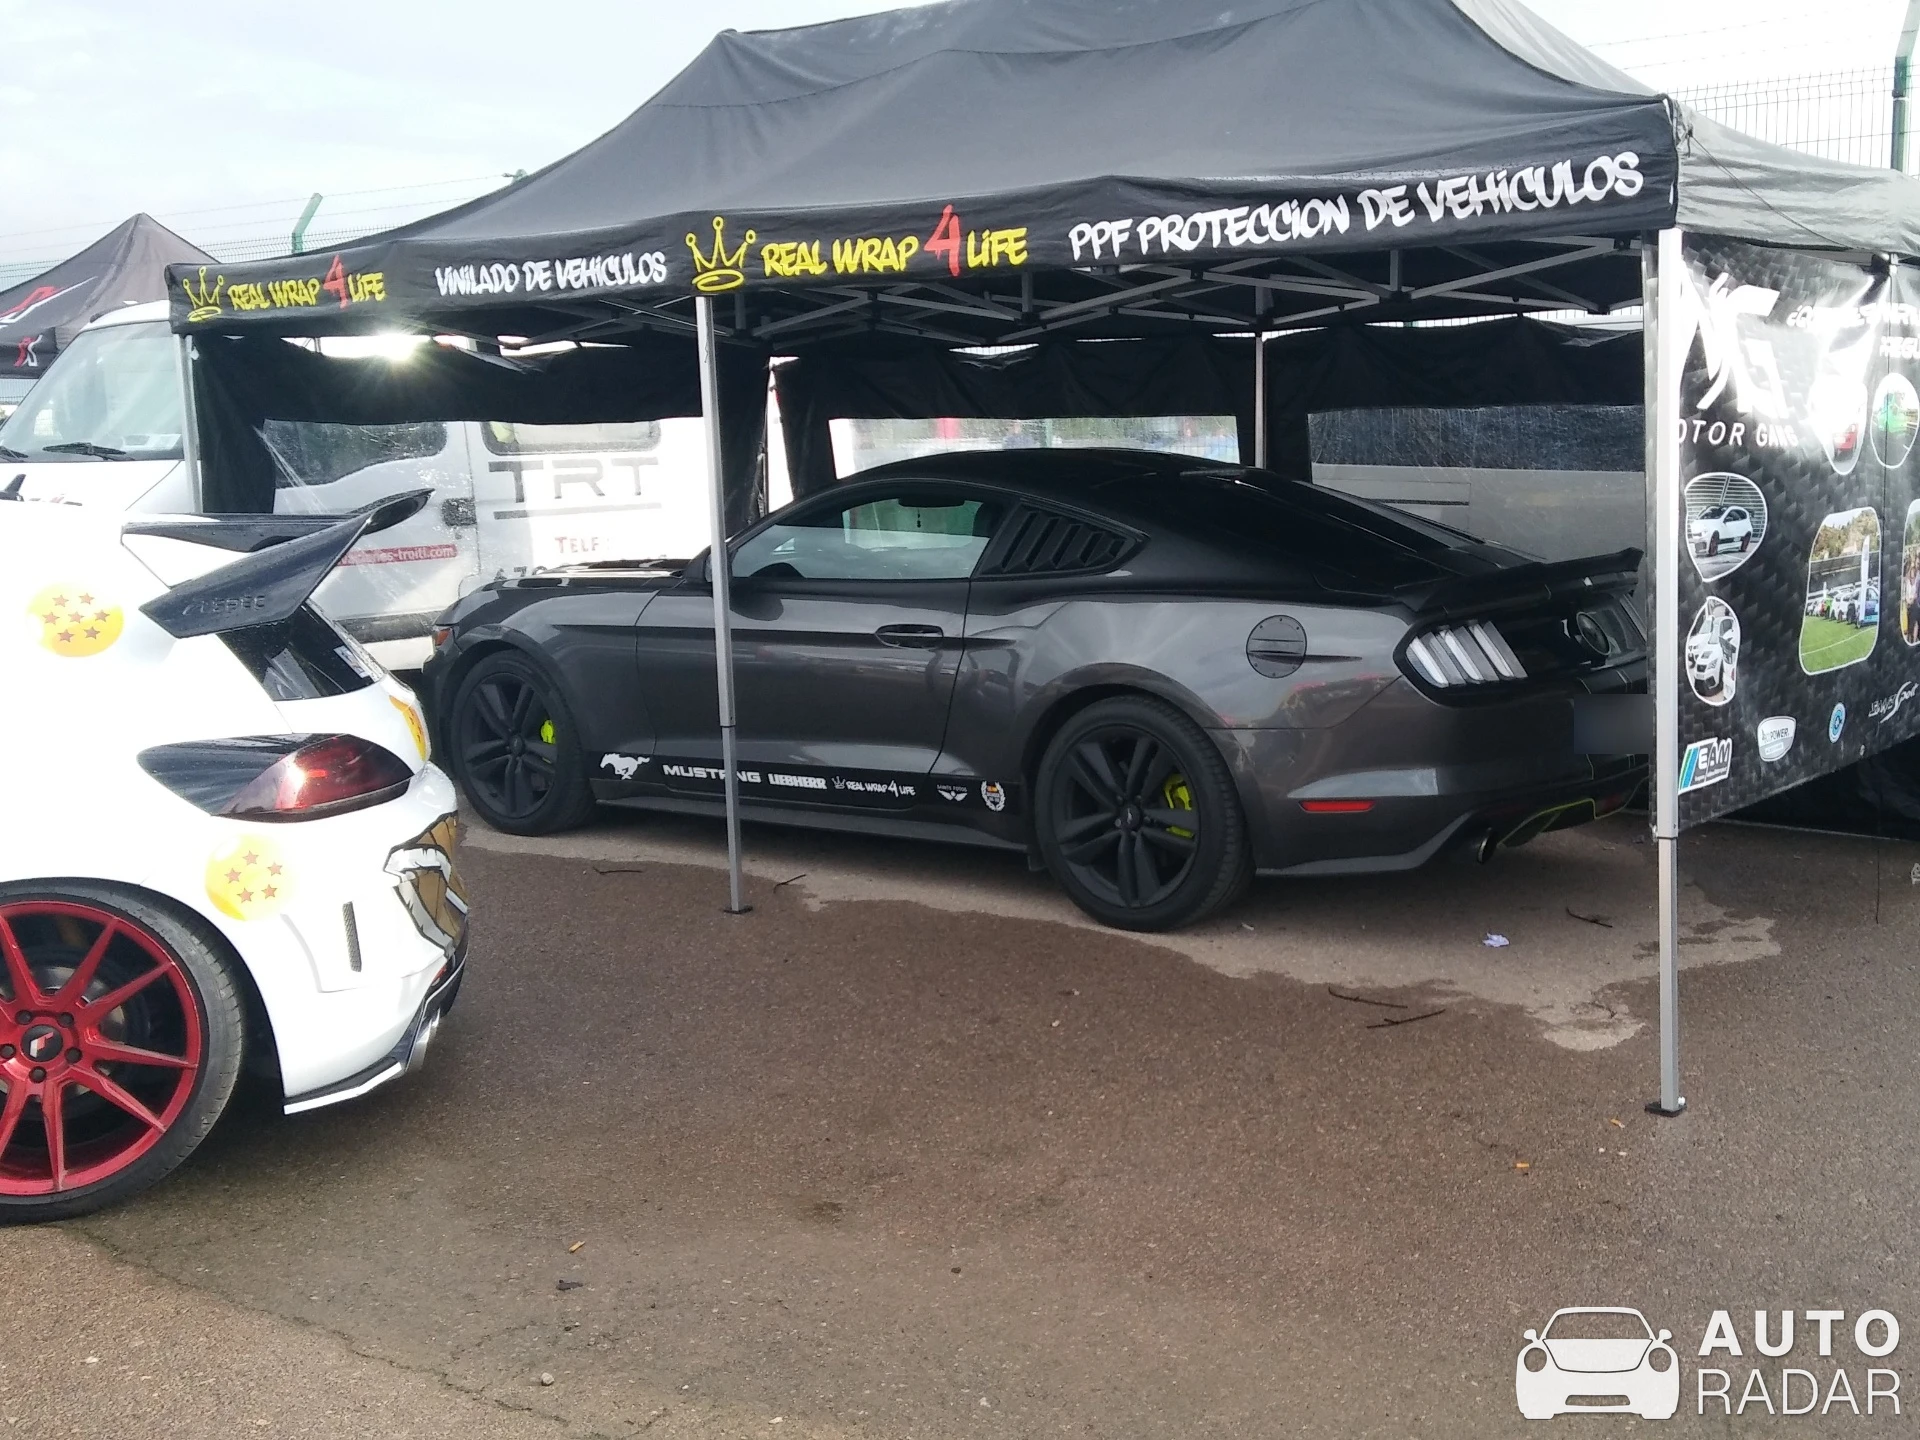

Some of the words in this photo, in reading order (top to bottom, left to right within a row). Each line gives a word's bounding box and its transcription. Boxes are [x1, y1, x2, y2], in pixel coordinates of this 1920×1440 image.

[1068, 217, 1133, 260] PPF
[1137, 194, 1350, 253] PROTECCION
[1357, 184, 1416, 231] DE
[1415, 151, 1645, 223] VEHICULOS
[761, 242, 827, 277] REAL
[832, 236, 919, 275] WRAP
[923, 204, 962, 278] 4
[966, 227, 1028, 269] LIFE
[227, 284, 270, 310] REAL
[268, 278, 321, 307] WRAP
[322, 254, 349, 309] 4
[347, 272, 385, 302] LIFE
[435, 261, 520, 296] VINILADO
[522, 259, 552, 292] DE
[554, 251, 667, 290] VEHICULOS
[1679, 418, 1746, 446] OTOR
[488, 457, 658, 503] TRT
[845, 781, 866, 791] REAL
[864, 782, 888, 793] WRAP
[887, 780, 899, 798] 4
[899, 785, 916, 796] LIFE
